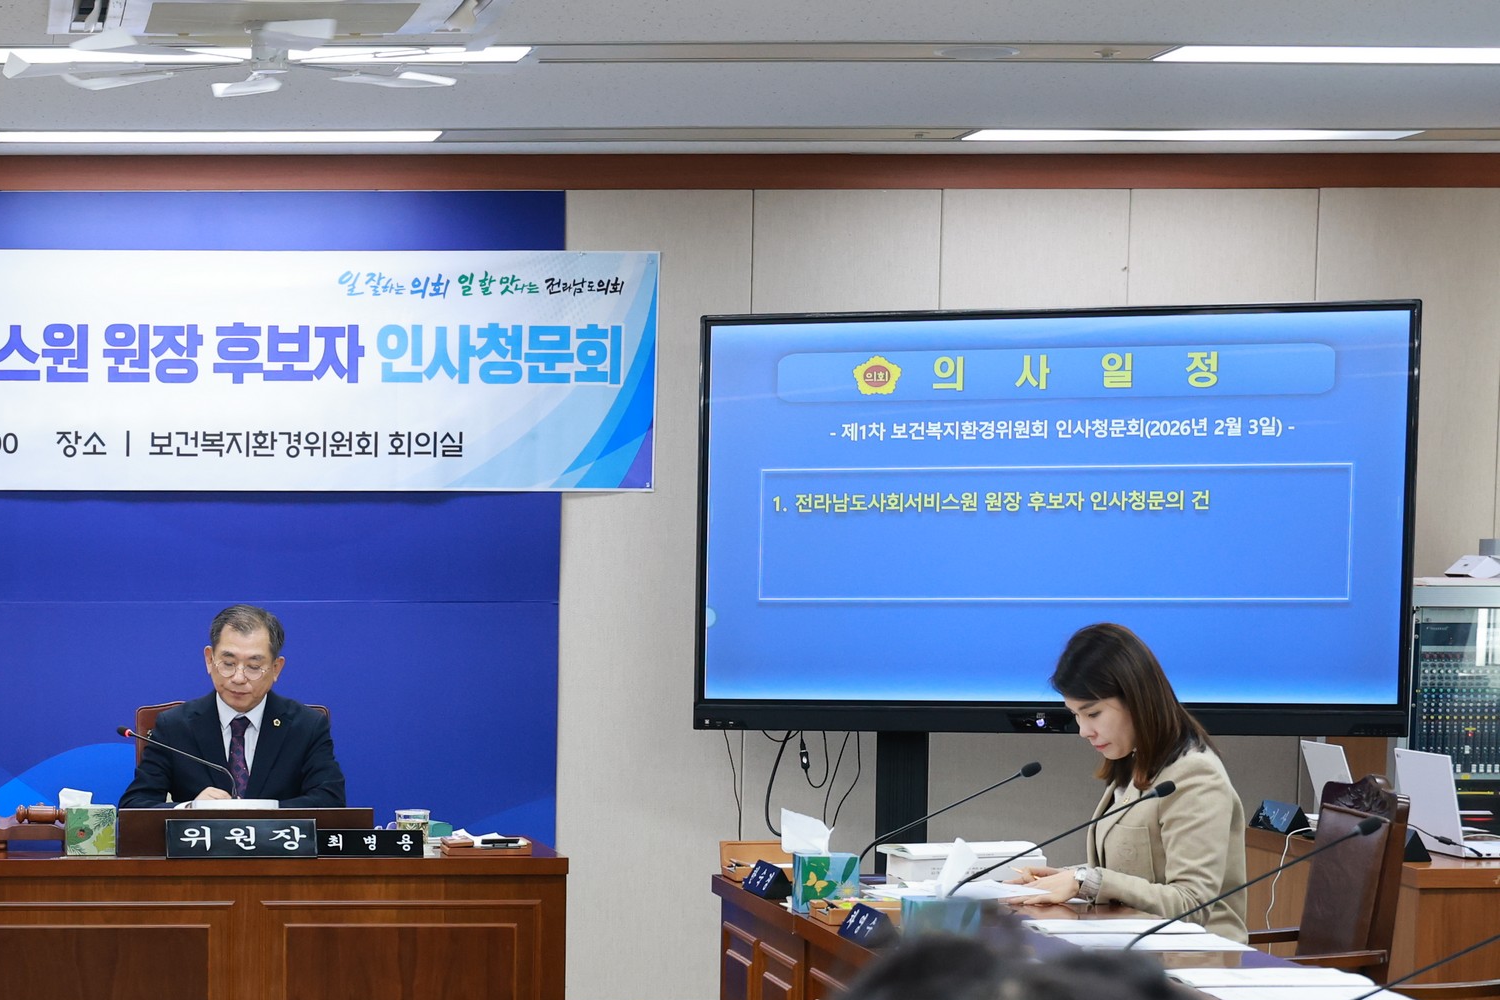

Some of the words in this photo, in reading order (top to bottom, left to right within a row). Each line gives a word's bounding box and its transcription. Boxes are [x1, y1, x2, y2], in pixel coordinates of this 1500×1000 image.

[410, 273, 450, 299] 의회
[545, 276, 625, 296] 전라남도의회
[102, 323, 204, 384] 원장
[215, 322, 365, 384] 후보자
[376, 323, 624, 386] 인사청문회
[864, 370, 888, 382] 의회
[841, 421, 886, 441] 제1차
[890, 419, 1049, 441] 보건복지환경위원회
[1056, 417, 1208, 439] 인사청문회(2026년
[1214, 417, 1242, 436] 2월
[1248, 416, 1282, 437] 3일)
[56, 430, 107, 458] 장소
[149, 430, 378, 458] 보건복지환경위원회
[388, 430, 463, 458] 회의실
[773, 496, 788, 512] 1.
[795, 491, 978, 513] 전라남도사회서비스원
[985, 491, 1022, 512] 원장
[1027, 490, 1085, 511] 후보자
[1090, 489, 1185, 511] 인사청문의
[1191, 489, 1210, 510] 건
[180, 825, 306, 851] 위원장
[327, 833, 414, 851] 최병용
